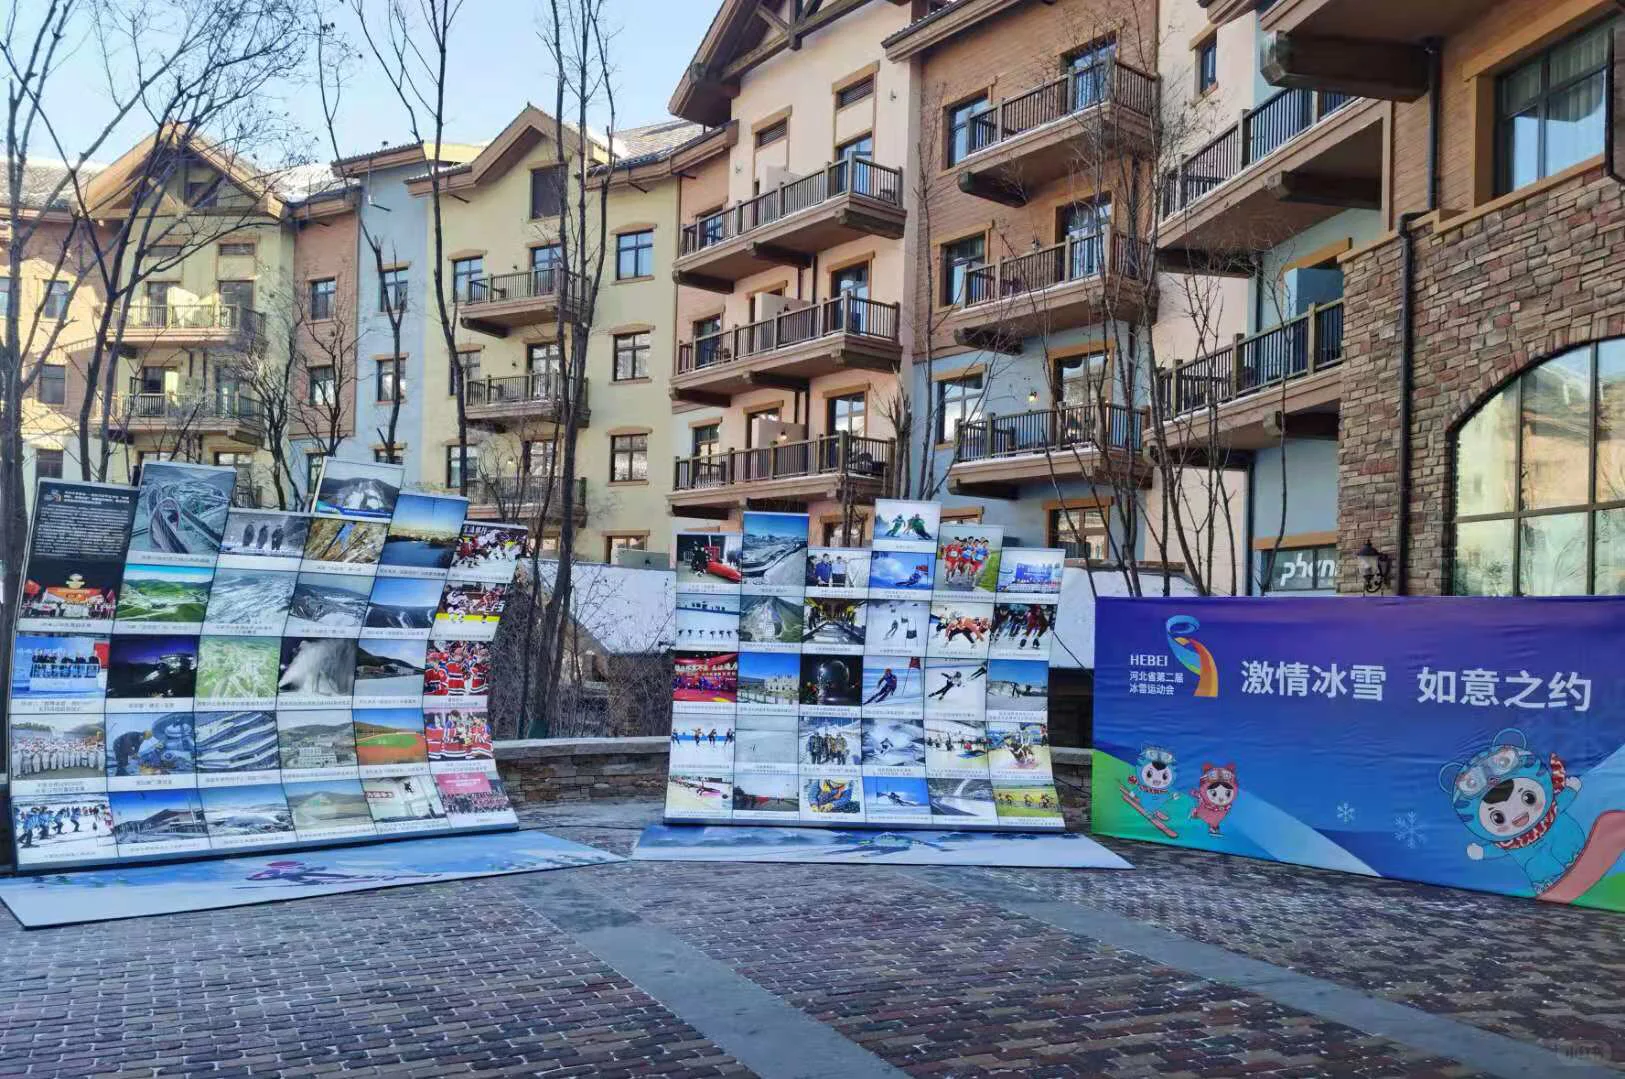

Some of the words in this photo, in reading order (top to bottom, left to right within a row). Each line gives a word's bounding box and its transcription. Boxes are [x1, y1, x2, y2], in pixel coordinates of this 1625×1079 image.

[1130, 654, 1168, 666] HEBEI
[1129, 671, 1184, 684] 河北省第二届
[1129, 683, 1175, 695] 冰雪运动会
[1241, 660, 1387, 702] 激情冰雪
[1417, 666, 1592, 713] 如意之约
